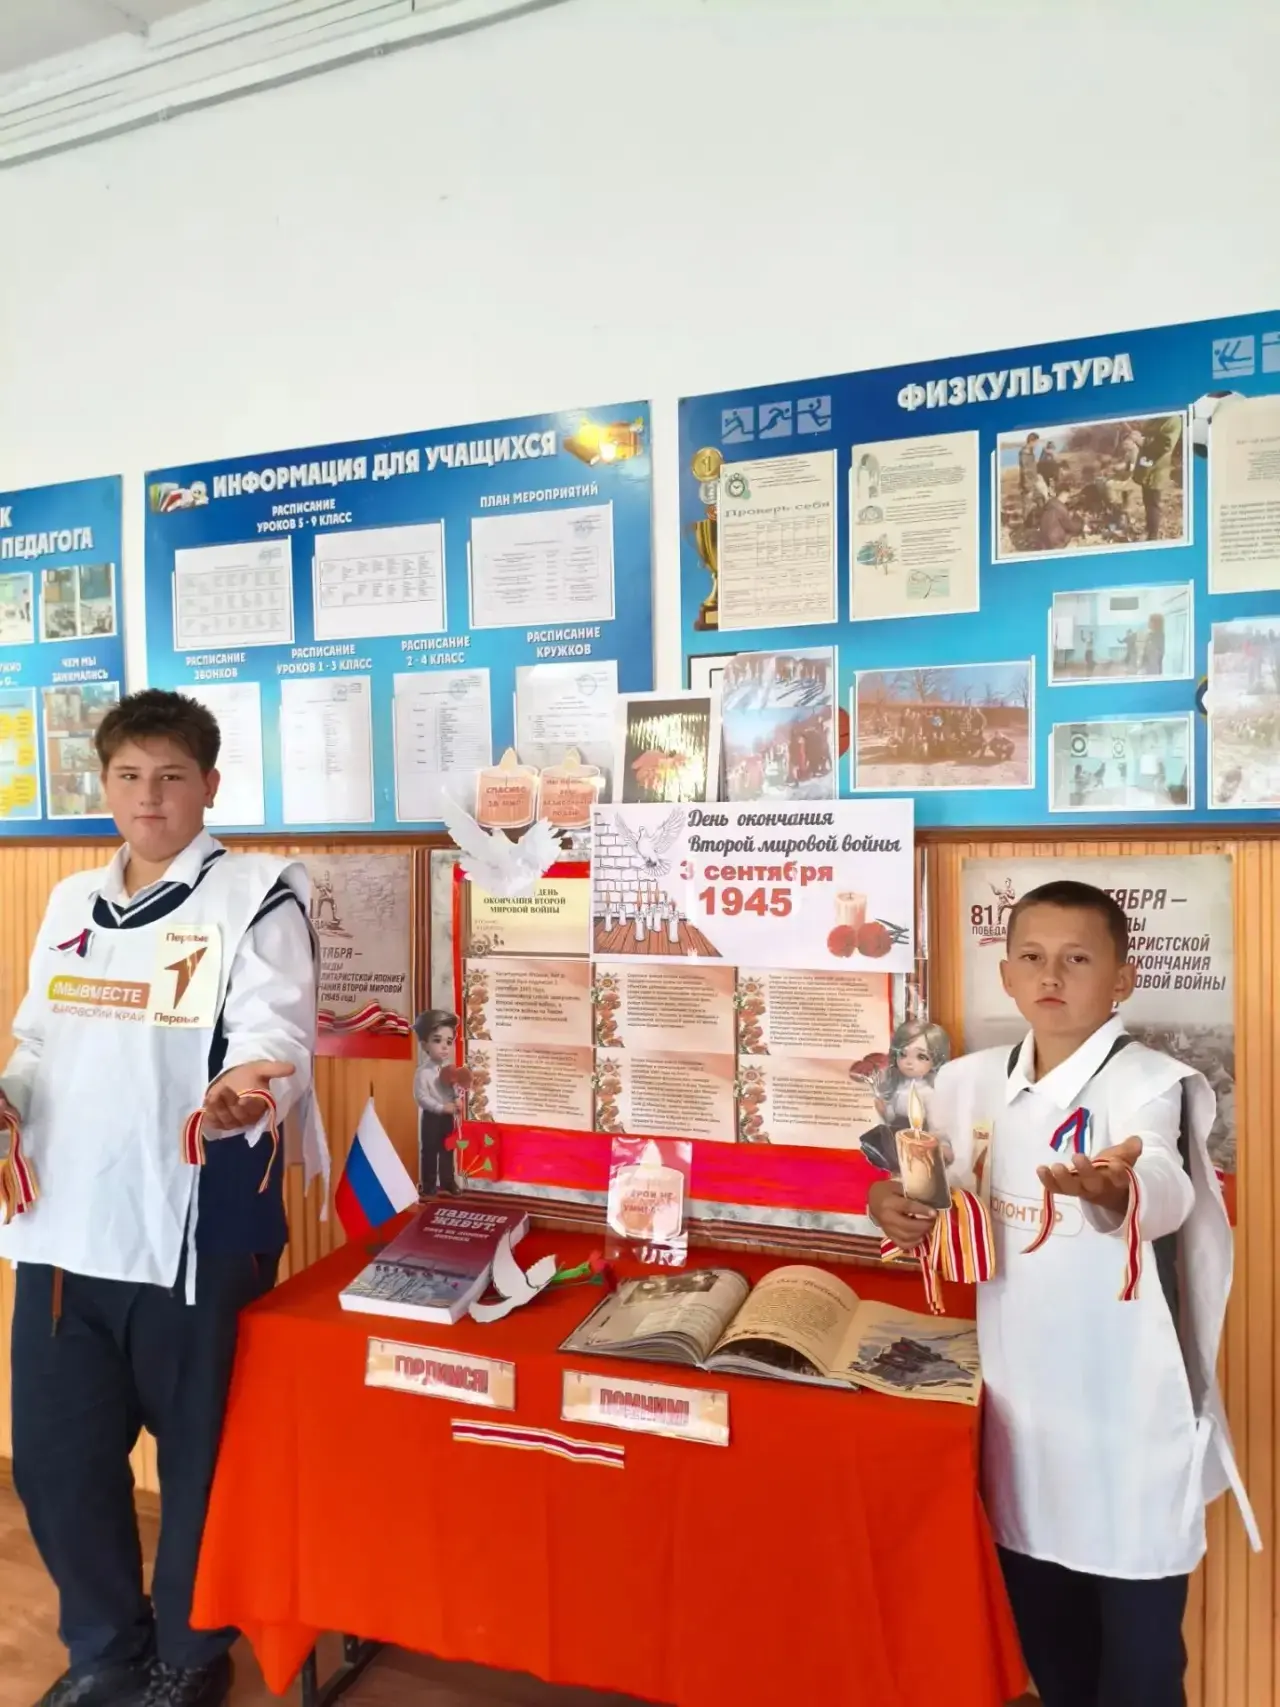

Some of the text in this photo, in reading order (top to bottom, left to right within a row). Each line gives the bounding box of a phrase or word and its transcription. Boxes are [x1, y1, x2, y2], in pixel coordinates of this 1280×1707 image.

[897, 353, 1134, 412] ФИЗКУЛЬТУРА
[213, 430, 557, 499] ИНФОРМАЦИЯ ДЛЯ УЧАЩИХСЯ
[480, 480, 599, 508] ПЛАН МЕРОПРИЯТИЙ
[272, 499, 336, 516] РАСПИСАНИЕ
[725, 501, 831, 518] Проверь себя
[256, 519, 296, 533] УРОКОВ
[298, 517, 304, 529] 5
[311, 516, 317, 527] 9
[319, 512, 353, 526] КЛАСС
[2, 527, 94, 560] ПЕДАГОГА
[401, 636, 471, 651] РАСПИСАНИЕ
[526, 627, 601, 643] РАСПИСАНИЕ
[186, 652, 246, 666] РАСПИСАНИЕ
[291, 644, 355, 659] РАСПИСАНИЕ
[406, 656, 413, 667] 2
[420, 655, 427, 665] 4
[430, 652, 465, 665] КЛАСС
[536, 644, 592, 658] КРУЖКОВ
[61, 656, 97, 668] ЧЕМ МЫ
[277, 662, 315, 675] УРОКОВ
[318, 661, 323, 672] 1
[331, 660, 337, 671] 3
[339, 658, 372, 670] КЛАСС
[52, 669, 109, 683] ЗАНИМАЛИСЬ
[194, 668, 238, 680] ЗВОНКОВ
[687, 809, 834, 828] День окончания
[687, 833, 902, 857] Второй мировой войны
[704, 861, 833, 886] сентября
[483, 896, 566, 905] ОКОНЧАНИЯ ВТОРОЙ
[537, 888, 559, 897] ДЕНЬ
[490, 905, 560, 914] МИРОВОЙ ВОЙНЫ
[698, 886, 793, 917] 1945
[971, 905, 993, 925] 81
[1128, 934, 1211, 951] АРИСТСКОЙ
[374, 973, 406, 983] ЯПОНИЕЙ
[1173, 972, 1226, 991] ВОЙНЫ
[342, 982, 368, 992] ВТОРОЙ
[369, 982, 402, 993] МИРОВОЙ
